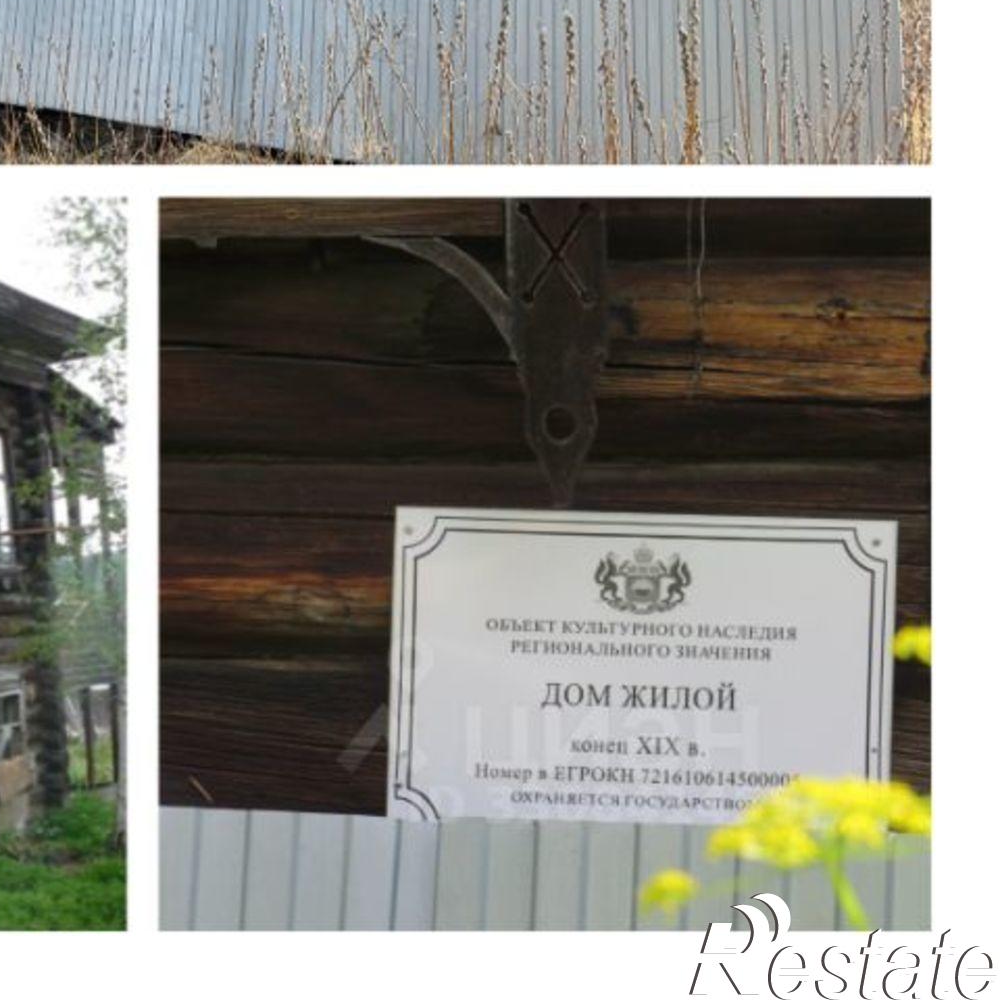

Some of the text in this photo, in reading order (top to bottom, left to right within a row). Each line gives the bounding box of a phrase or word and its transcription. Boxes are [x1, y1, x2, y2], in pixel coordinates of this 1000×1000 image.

[485, 618, 798, 641] ОБЪЕКТ КУЛЬТУРНОГО НАСЛЕДИЯ
[510, 639, 772, 661] РЕГИОНАЛЬНОГО ЗНАЧЕНИЯ
[541, 682, 736, 711] ДОМ ЖИЛОЙ
[570, 736, 707, 757] конец XIX в.
[473, 762, 533, 783] Номер
[538, 769, 548, 781] в
[553, 765, 635, 783] ЕГРОКН
[509, 791, 620, 807] ОХРАНЯЕТСЯ
[624, 793, 756, 812] ГОСУДАРСТВО
